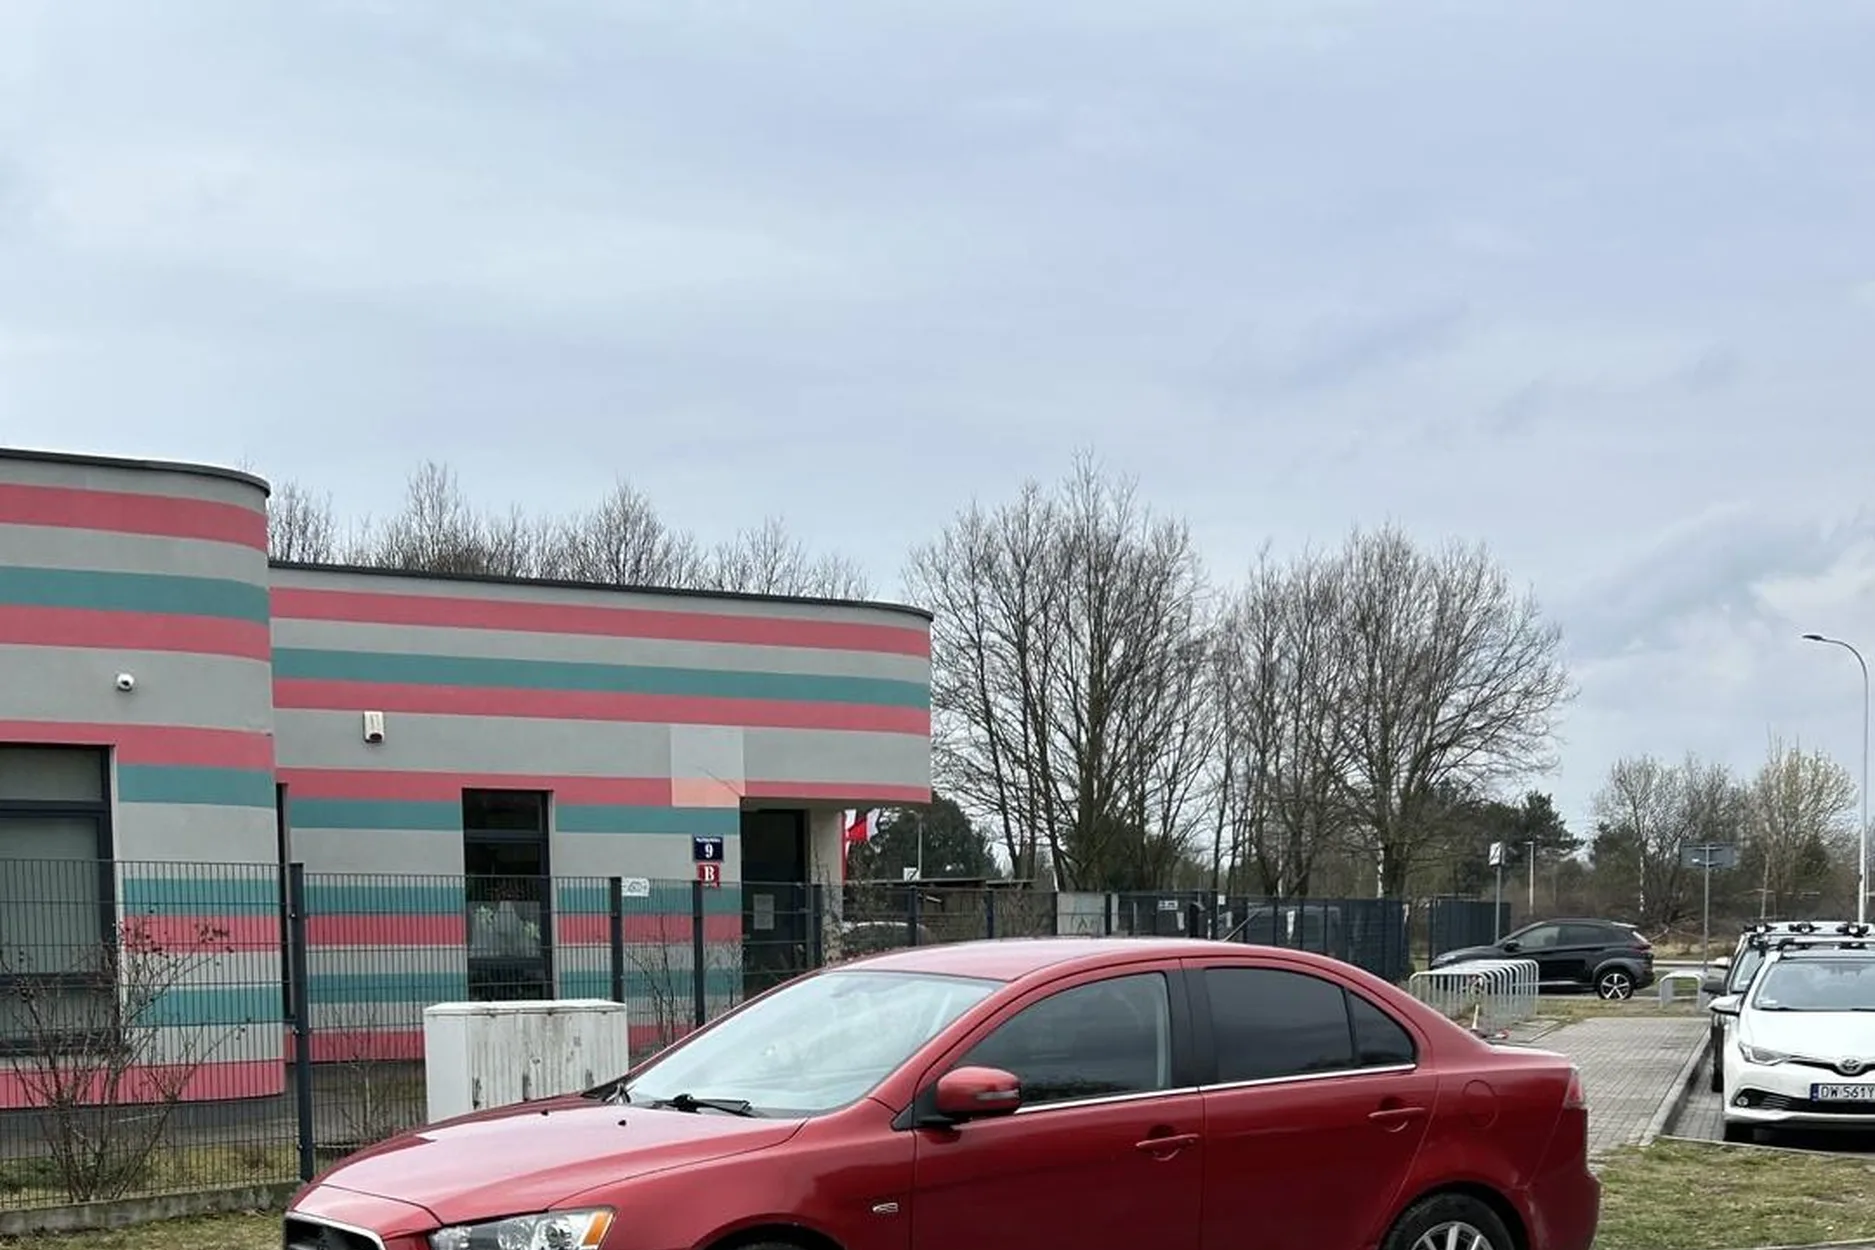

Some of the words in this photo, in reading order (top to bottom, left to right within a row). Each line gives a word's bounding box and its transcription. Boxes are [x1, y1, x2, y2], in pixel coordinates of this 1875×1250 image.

[704, 843, 714, 859] 9
[703, 865, 715, 881] B
[1821, 1086, 1839, 1098] DW
